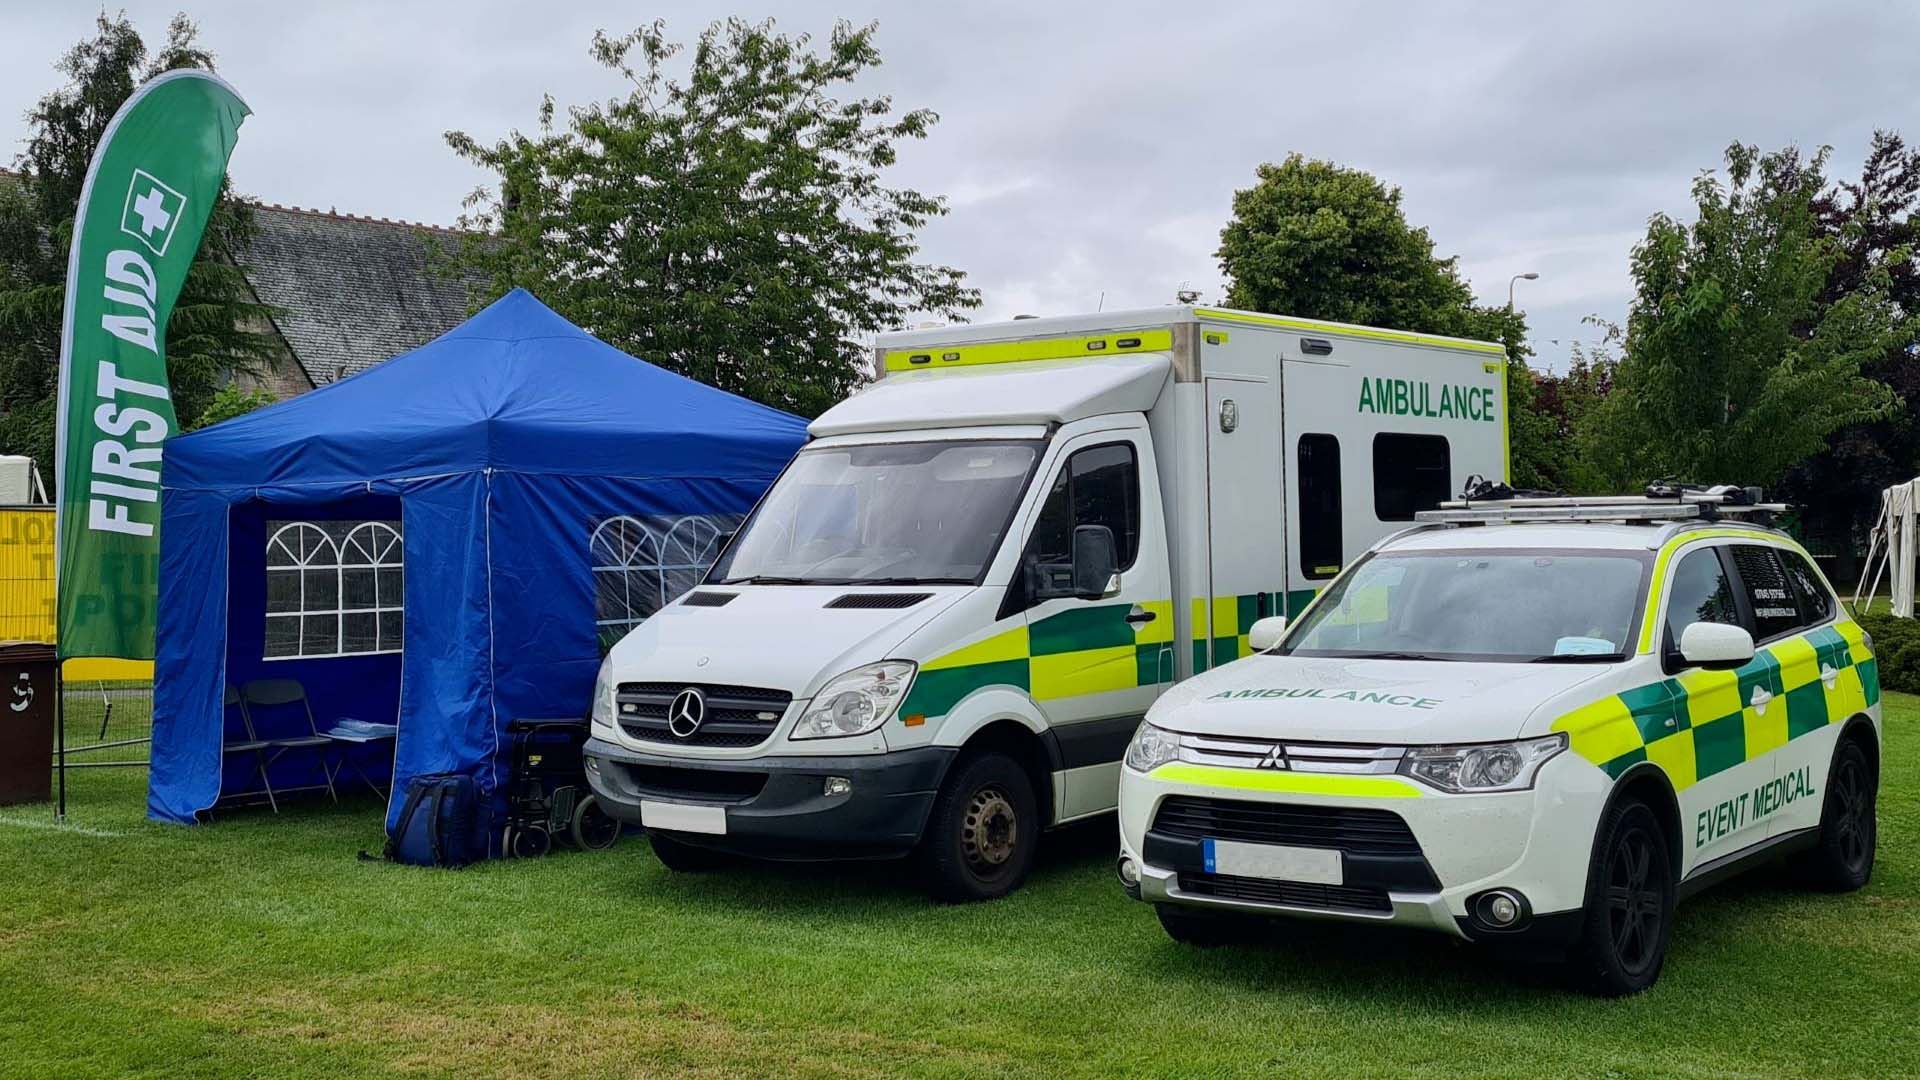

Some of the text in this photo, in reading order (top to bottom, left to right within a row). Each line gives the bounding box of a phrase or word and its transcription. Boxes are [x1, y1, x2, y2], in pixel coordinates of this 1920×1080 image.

[101, 249, 158, 356] AID
[1358, 376, 1495, 422] AMBULANCE
[88, 360, 169, 537] FIRST
[1207, 687, 1445, 710] AMBULANCE
[1695, 765, 1816, 849] EVENT MEDICAL
